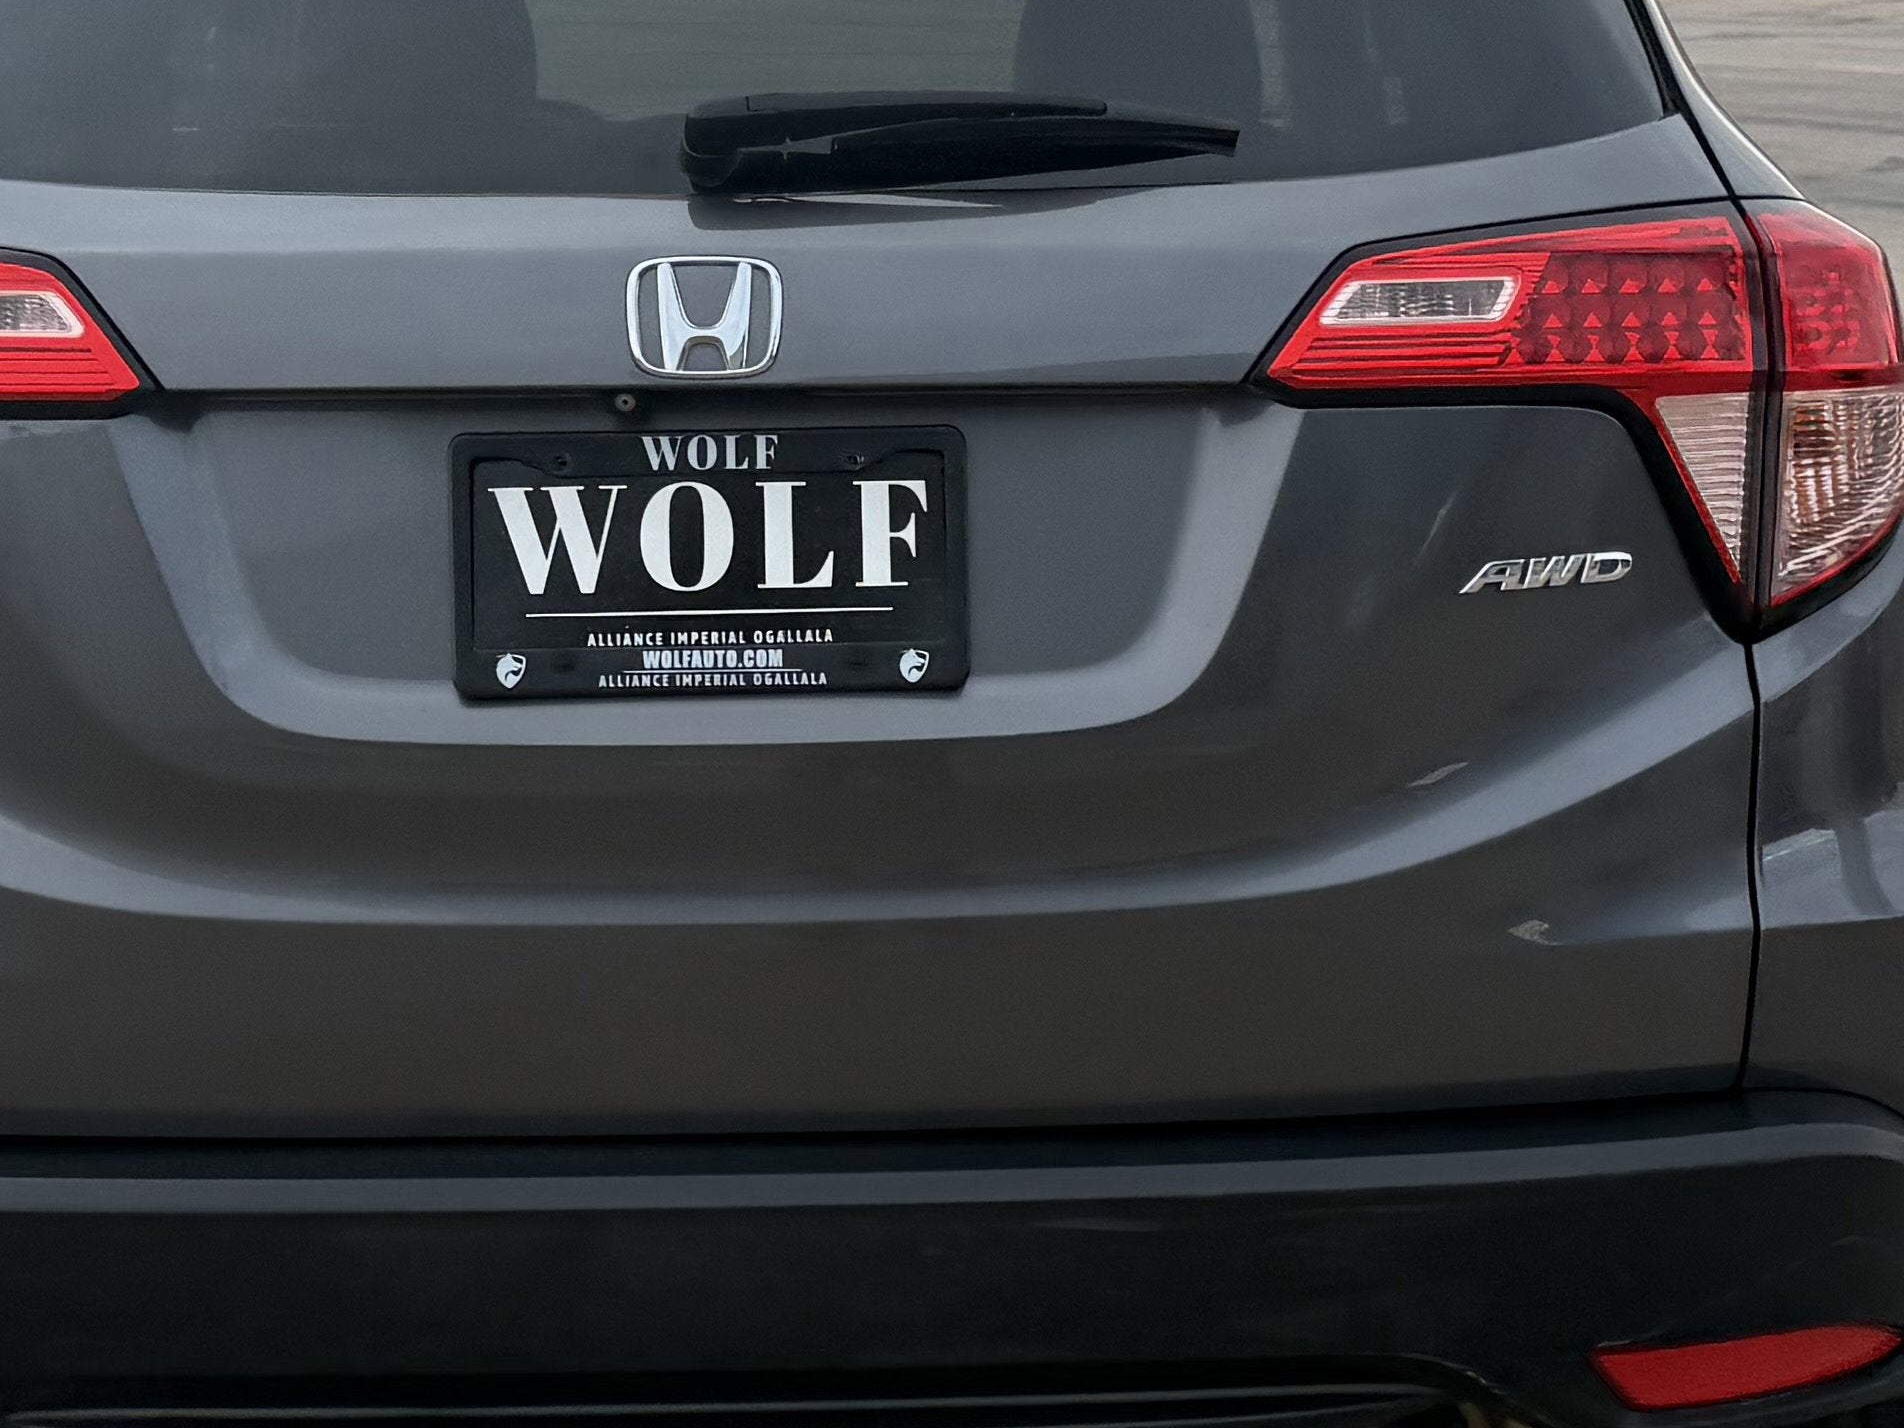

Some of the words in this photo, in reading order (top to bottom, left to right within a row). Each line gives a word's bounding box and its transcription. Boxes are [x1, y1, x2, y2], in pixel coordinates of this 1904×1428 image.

[641, 434, 779, 471] WOLF
[488, 480, 928, 595] WOLF
[1459, 551, 1633, 594] AWD
[587, 632, 664, 647] ALLIANCE
[670, 630, 746, 645] IMPERIAL
[753, 628, 834, 644] OGALLALA
[643, 648, 783, 669] WOLFAUTO.COM
[598, 674, 670, 688] ALLIANCE
[675, 673, 748, 687] IMPERIAL
[753, 672, 827, 686] OGALLALA
